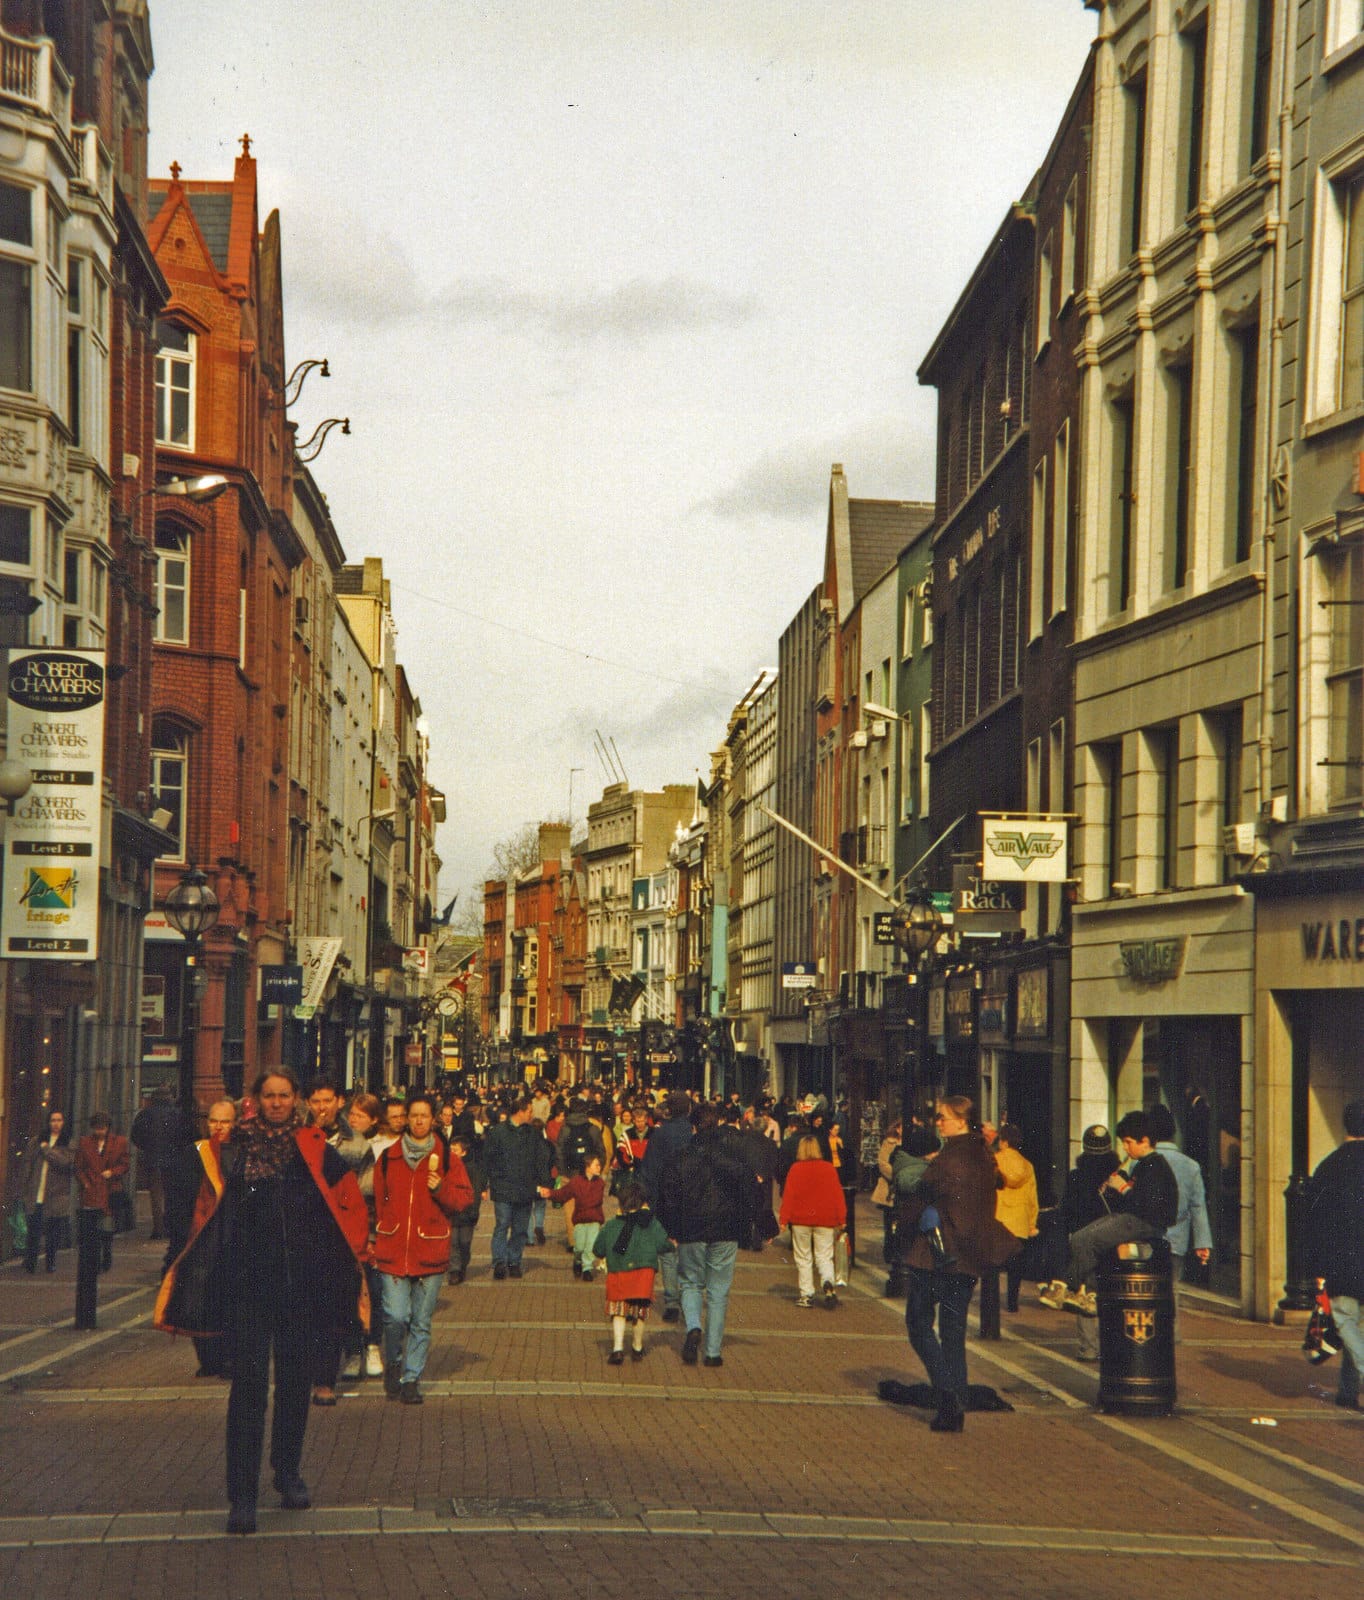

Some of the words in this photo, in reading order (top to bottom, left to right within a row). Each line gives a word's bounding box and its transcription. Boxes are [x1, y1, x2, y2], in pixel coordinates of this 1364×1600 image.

[27, 661, 88, 678] ROBERT
[11, 677, 102, 695] CHAMBERS
[32, 722, 78, 735] ROBERT
[21, 733, 88, 747] CHAMBERS
[33, 772, 64, 783] Level
[70, 773, 76, 783] 1
[31, 796, 78, 809] ROBERT
[19, 807, 87, 820] CHAMBERS
[31, 844, 62, 854] Level
[66, 844, 75, 854] 3
[997, 837, 1052, 858] AIRWAVE
[967, 876, 999, 897] Tie
[961, 890, 1012, 909] Rack
[26, 909, 70, 924] fringe
[27, 939, 58, 950] Level
[63, 940, 71, 950] 2
